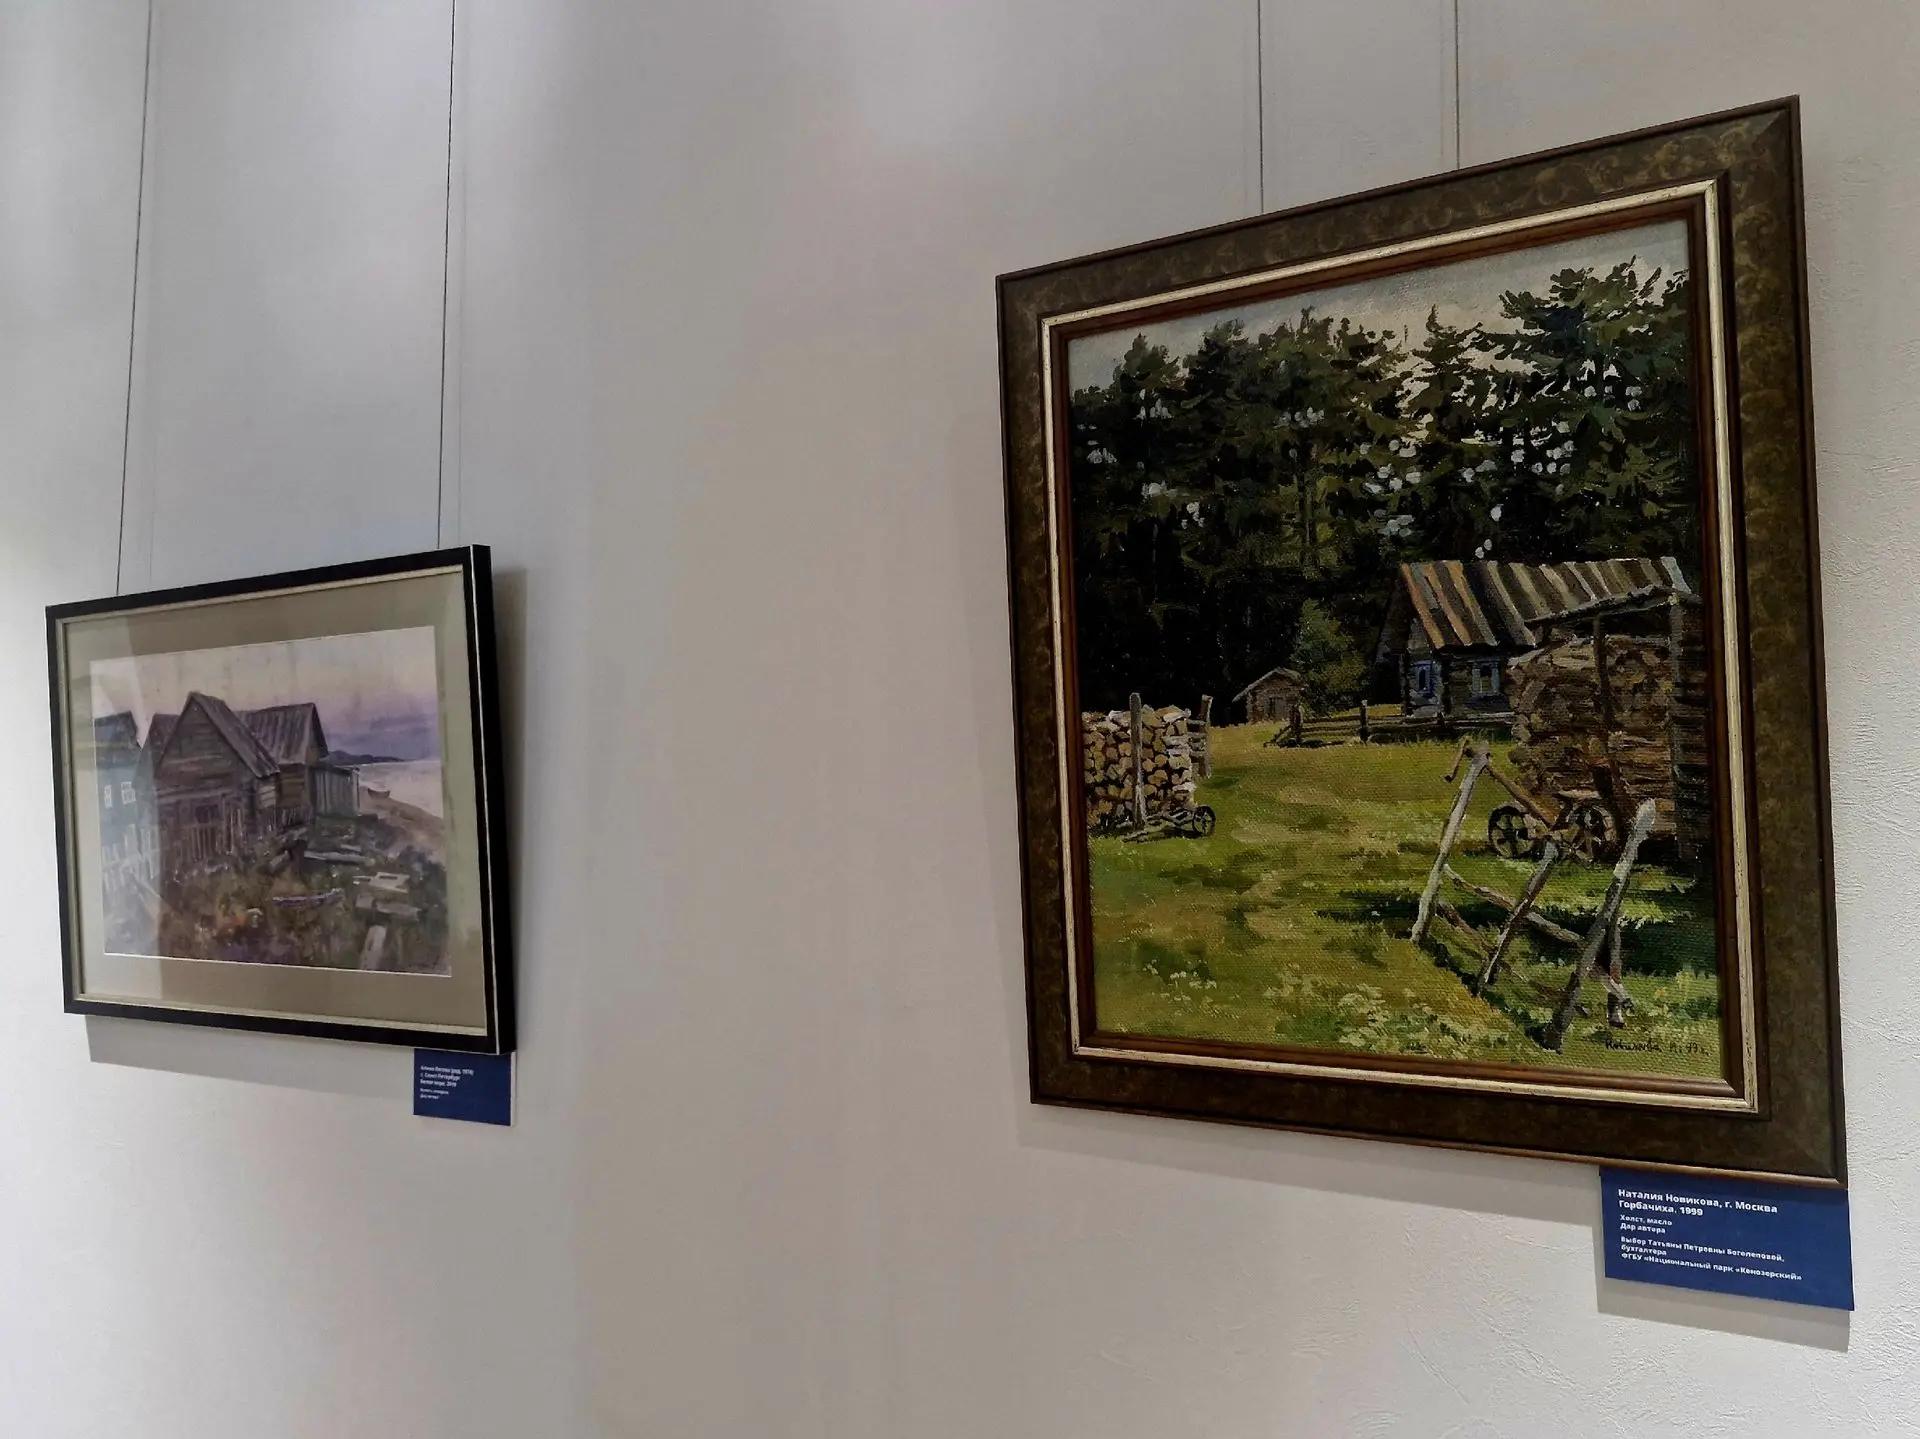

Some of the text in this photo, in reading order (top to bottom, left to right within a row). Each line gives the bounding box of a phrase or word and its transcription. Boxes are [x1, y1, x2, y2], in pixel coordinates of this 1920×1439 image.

[1618, 1189, 1778, 1213] Наталия Новикова, г. Москва
[1679, 1207, 1703, 1216] 1999
[1647, 1217, 1673, 1226] масло
[1620, 1222, 1666, 1235] Дар автора
[1621, 1236, 1646, 1246] Выбор
[1648, 1239, 1682, 1250] Татьяны
[1683, 1243, 1725, 1254] Петровны
[1621, 1244, 1667, 1256] бухгалтера
[1621, 1252, 1803, 1281] ФГБУ «Национальный парк «Кенозерский»
